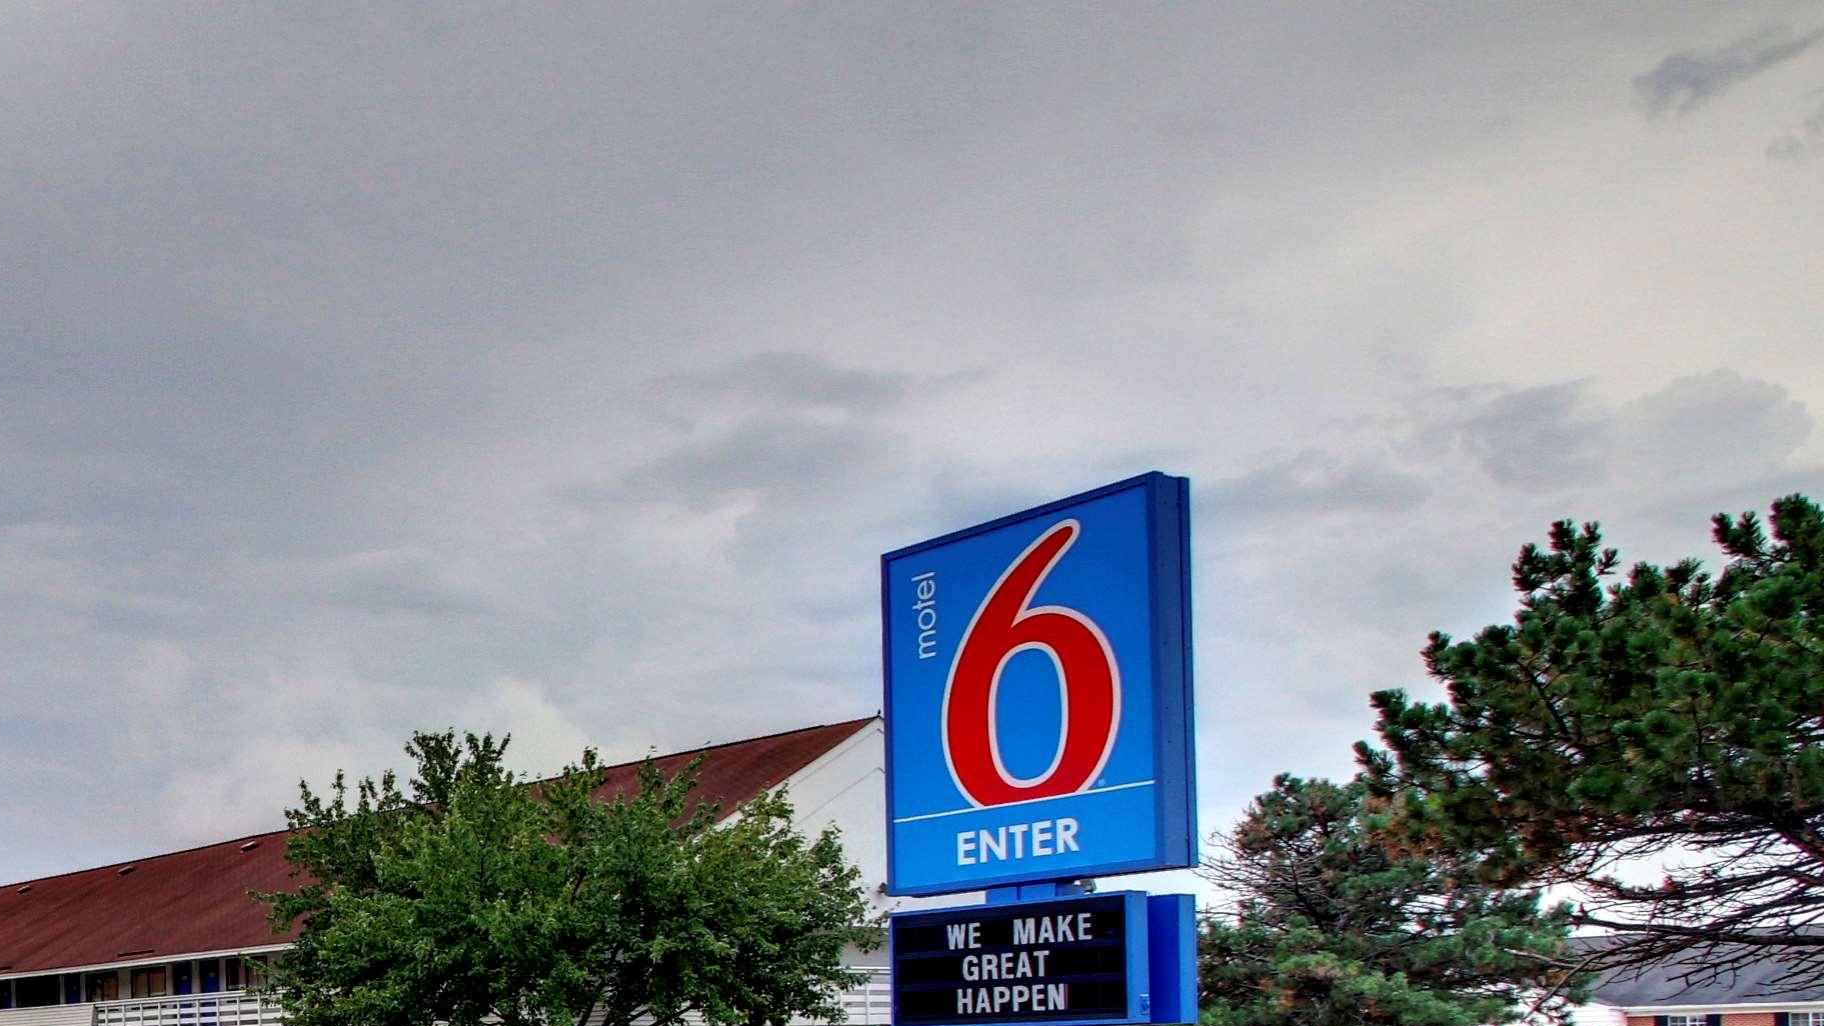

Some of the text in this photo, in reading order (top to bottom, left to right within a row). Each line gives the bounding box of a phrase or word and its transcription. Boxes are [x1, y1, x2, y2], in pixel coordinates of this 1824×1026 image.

[911, 518, 1122, 809] motel 6
[956, 817, 1080, 866] ENTER
[946, 912, 1093, 950] WE MAKE
[962, 950, 1050, 981] GREAT
[956, 983, 1068, 1014] HAPPEN
